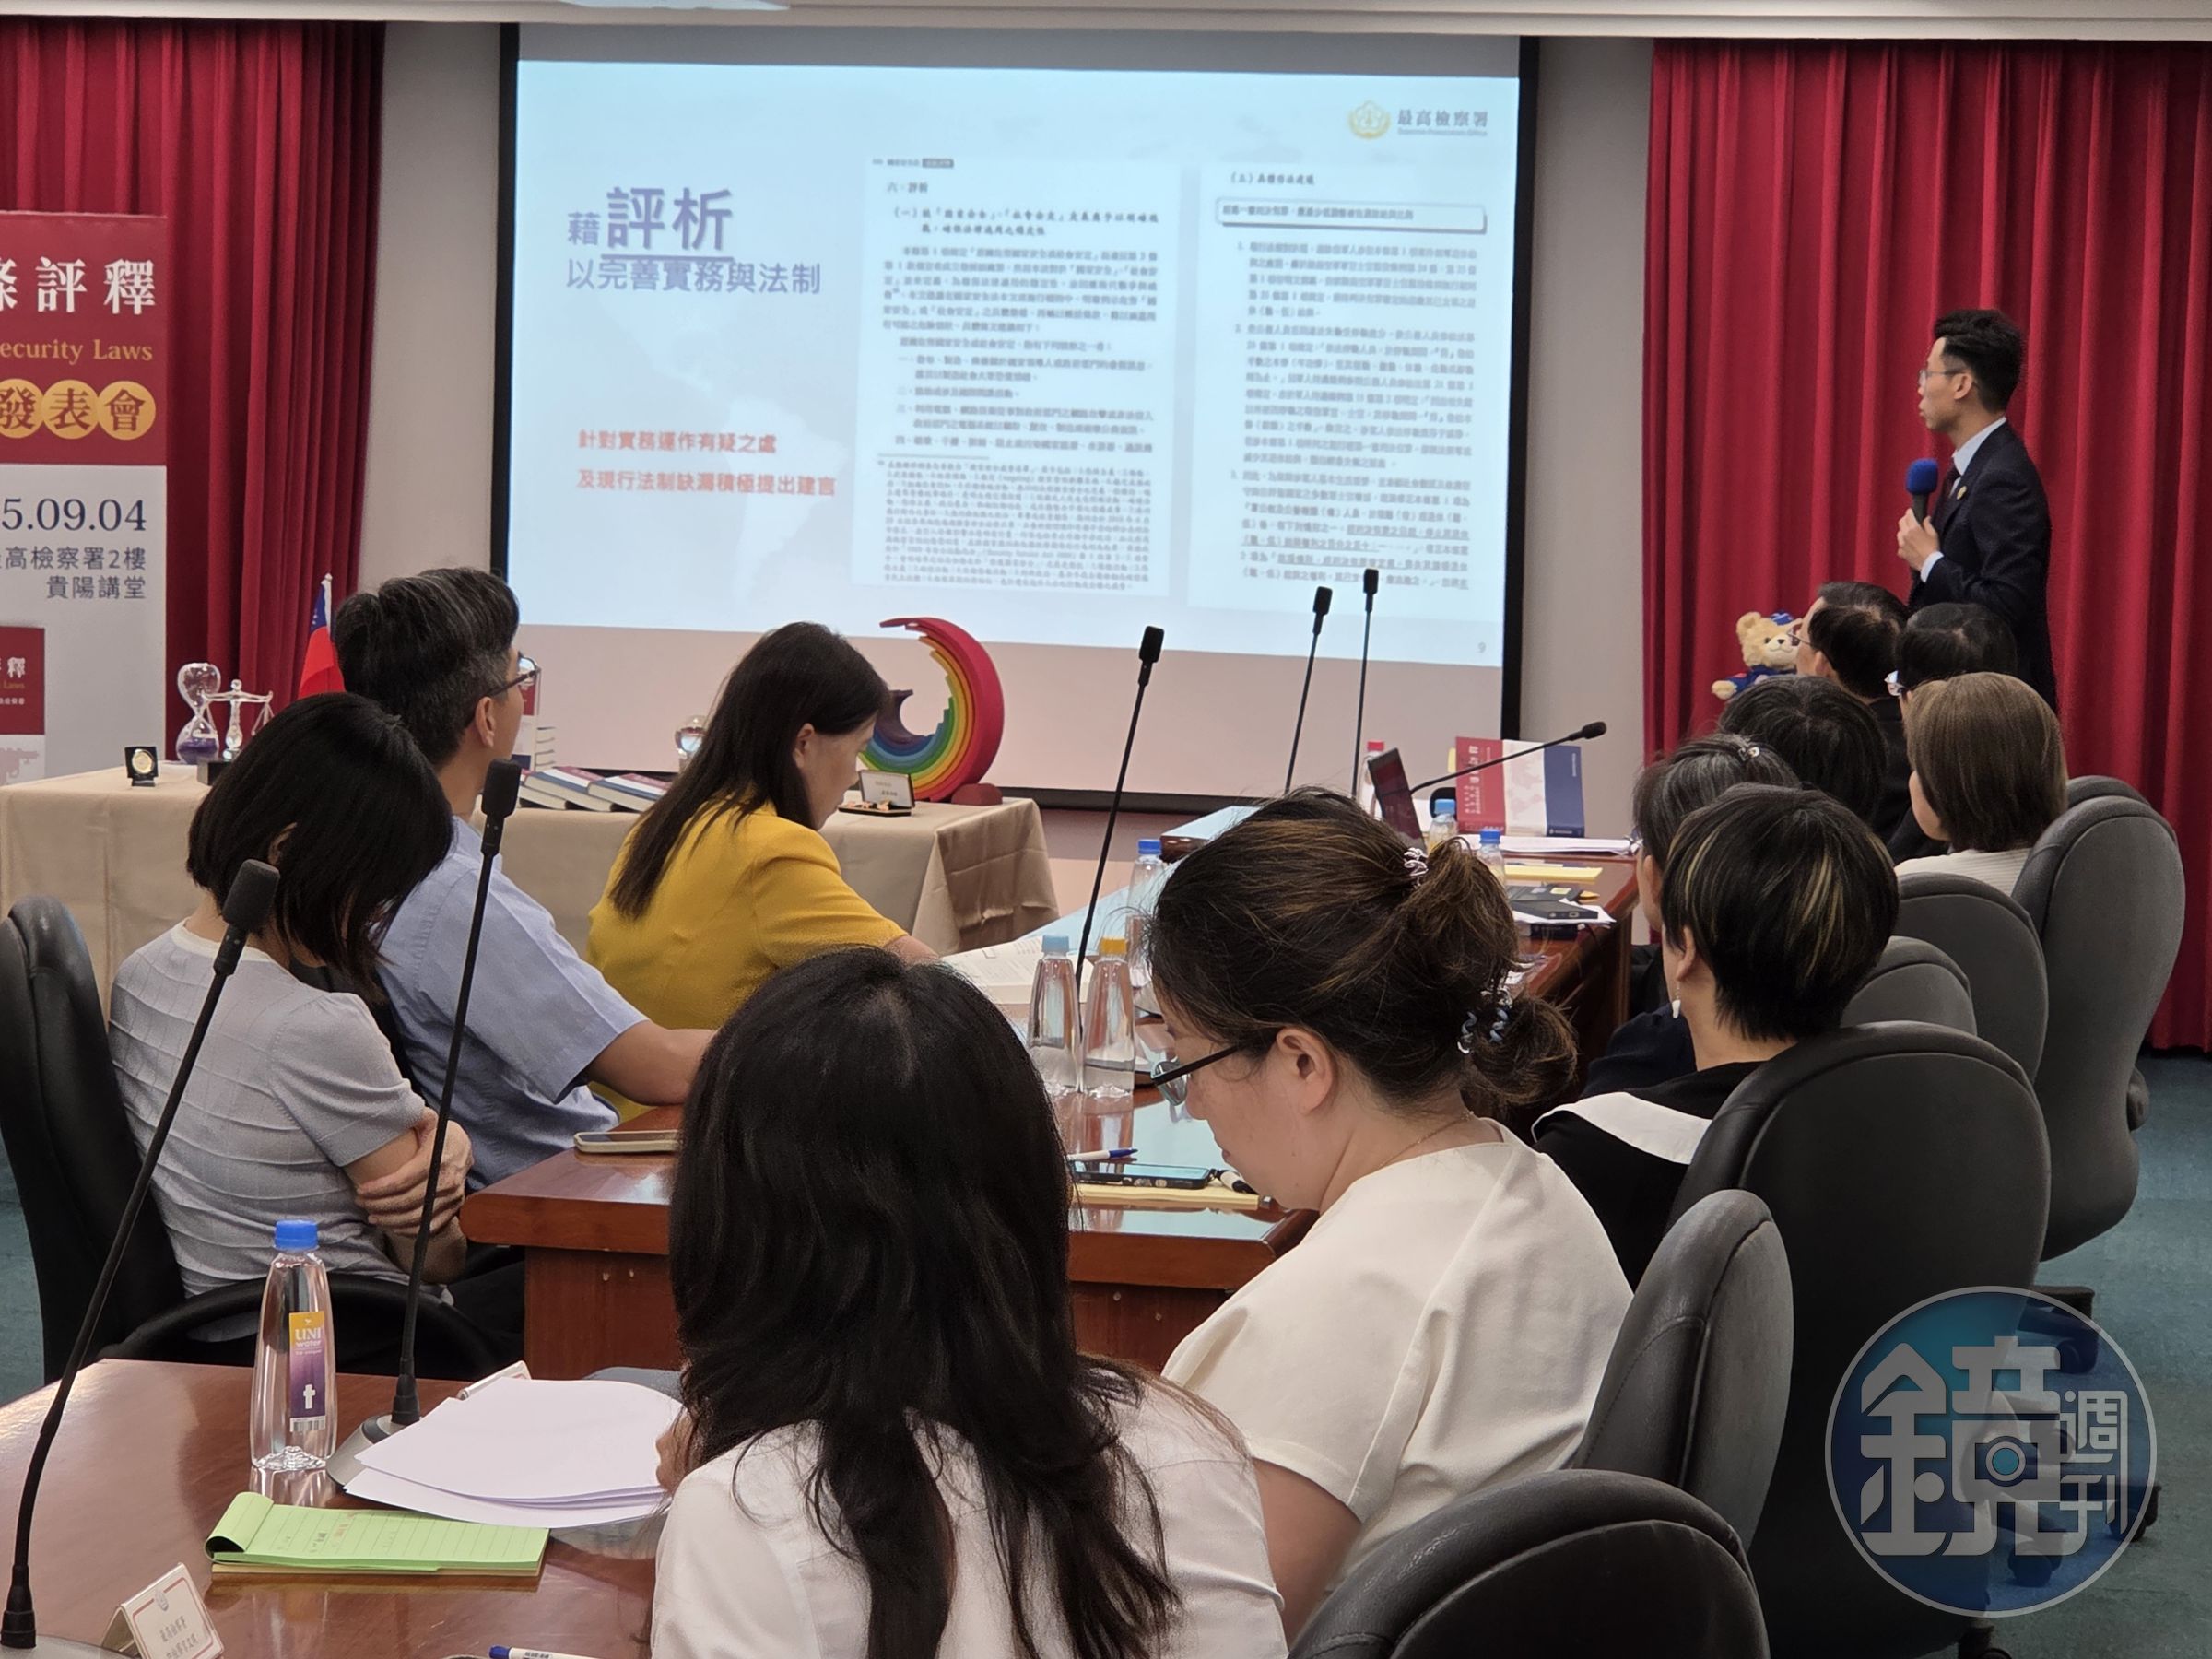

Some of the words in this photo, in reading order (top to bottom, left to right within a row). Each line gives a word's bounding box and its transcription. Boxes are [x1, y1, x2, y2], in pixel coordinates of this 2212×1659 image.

[566, 257, 821, 294] 以完善實務與法制
[93, 339, 153, 361] Laws
[578, 429, 777, 453] 針對實務運作有疑之處
[576, 468, 837, 496] 及現行法制缺漏積極提出建言
[1, 498, 147, 531] 5.09.04
[0, 546, 146, 571] 高檢察署2樓
[46, 575, 146, 599] 貴陽講堂
[295, 1327, 322, 1340] UNI
